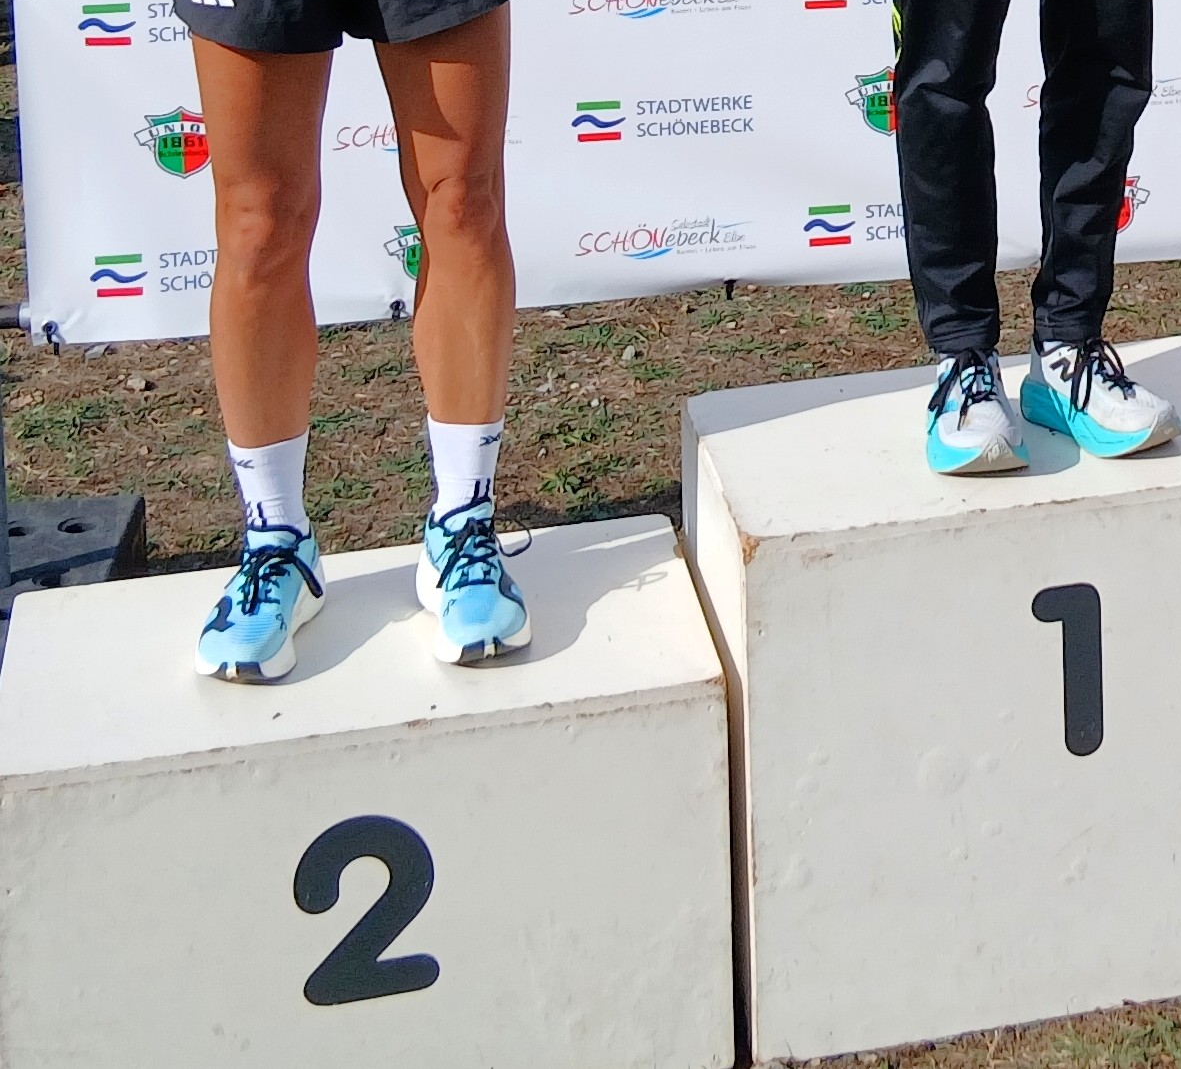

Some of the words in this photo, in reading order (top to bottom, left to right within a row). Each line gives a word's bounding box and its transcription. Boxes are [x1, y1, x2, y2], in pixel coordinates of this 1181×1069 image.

[858, 82, 891, 97] UNI
[637, 95, 752, 115] STADTWERKE
[147, 123, 201, 139] UNIO
[637, 118, 753, 137] SCHÖNEBECK
[575, 224, 720, 256] SCHÖNebeck
[158, 248, 217, 268] STADT
[1030, 582, 1102, 757] 1
[293, 814, 441, 1007] 2
